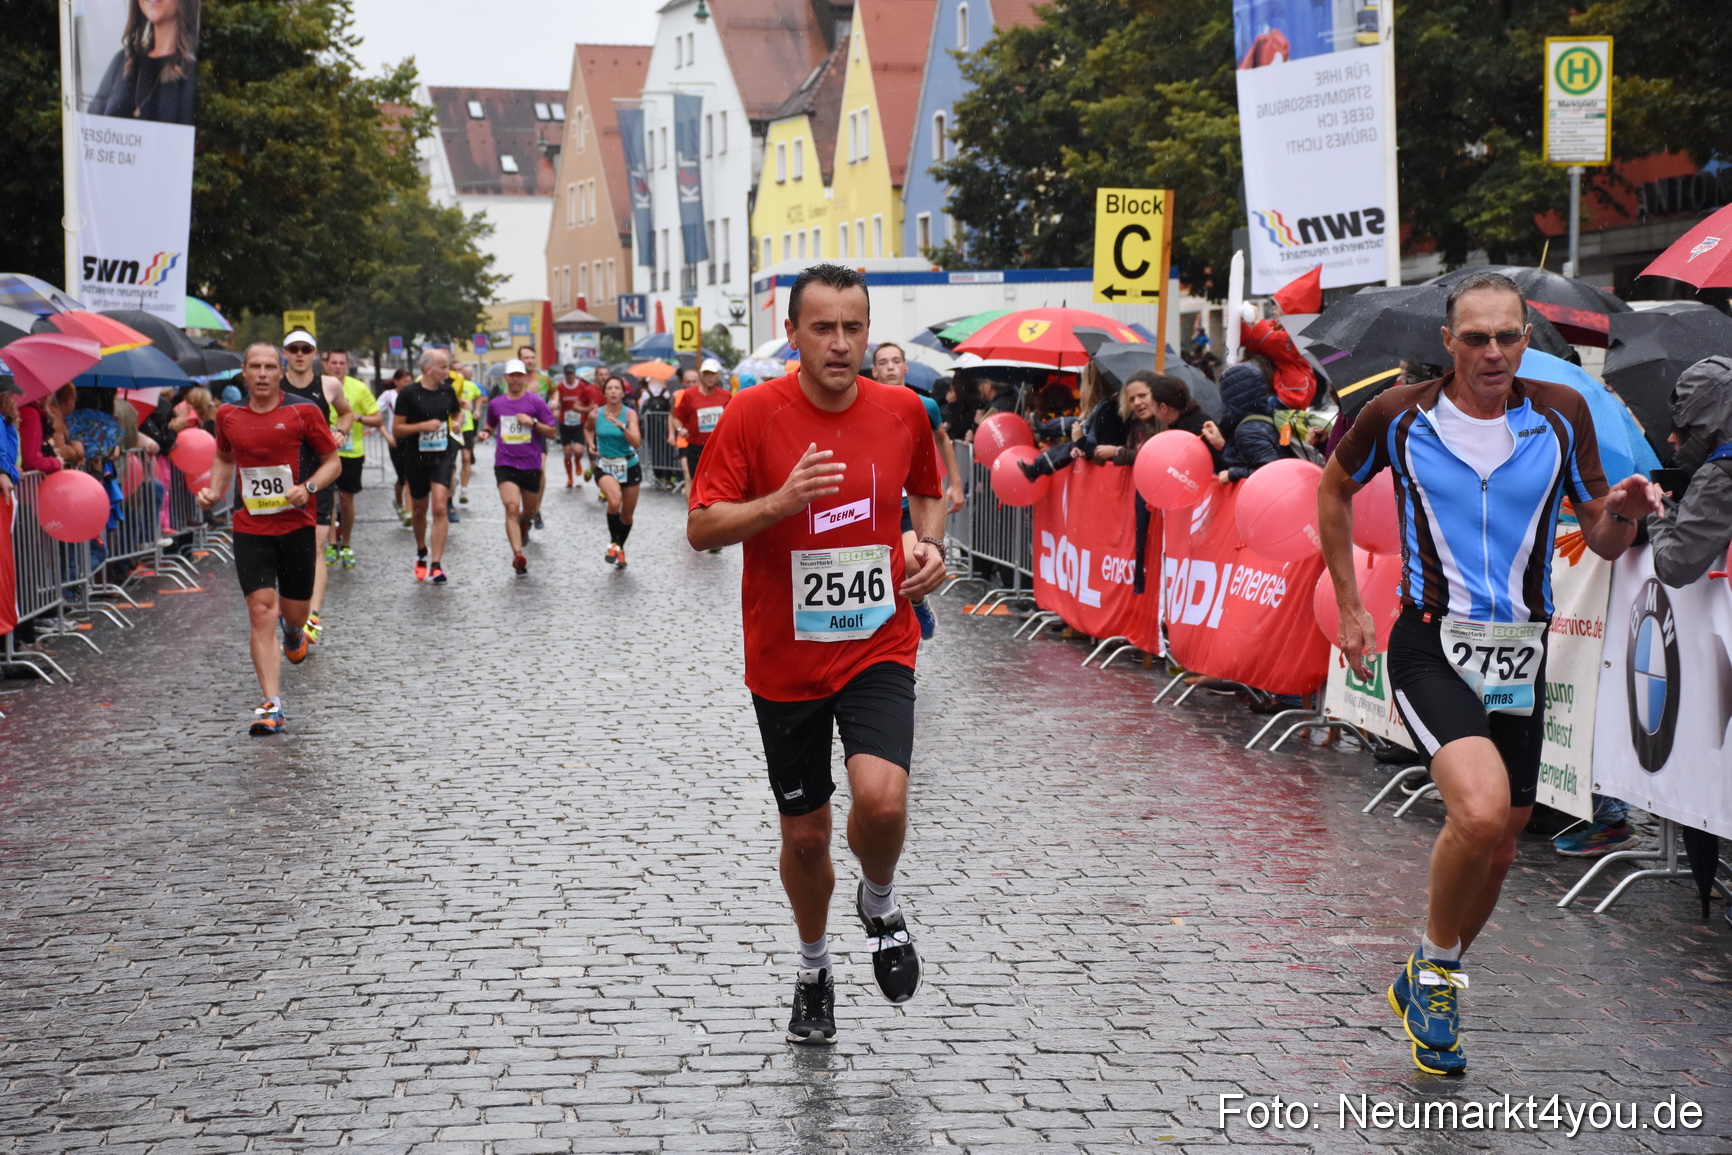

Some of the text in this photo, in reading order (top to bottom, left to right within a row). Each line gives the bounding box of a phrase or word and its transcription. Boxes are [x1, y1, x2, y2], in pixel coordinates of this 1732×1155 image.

[97, 149, 116, 163] SIE
[118, 152, 136, 165] DA!
[1106, 194, 1163, 215] Block
[1113, 223, 1152, 279] C
[83, 256, 140, 285] swn
[681, 320, 694, 341] D
[510, 423, 522, 434] 69
[251, 477, 284, 496] 298
[829, 508, 856, 524] DEHN
[838, 549, 885, 563] BOCK
[803, 567, 885, 606] 2546
[829, 613, 863, 629] Adolf
[1492, 625, 1537, 638] BOCK
[1452, 642, 1535, 681] 2752
